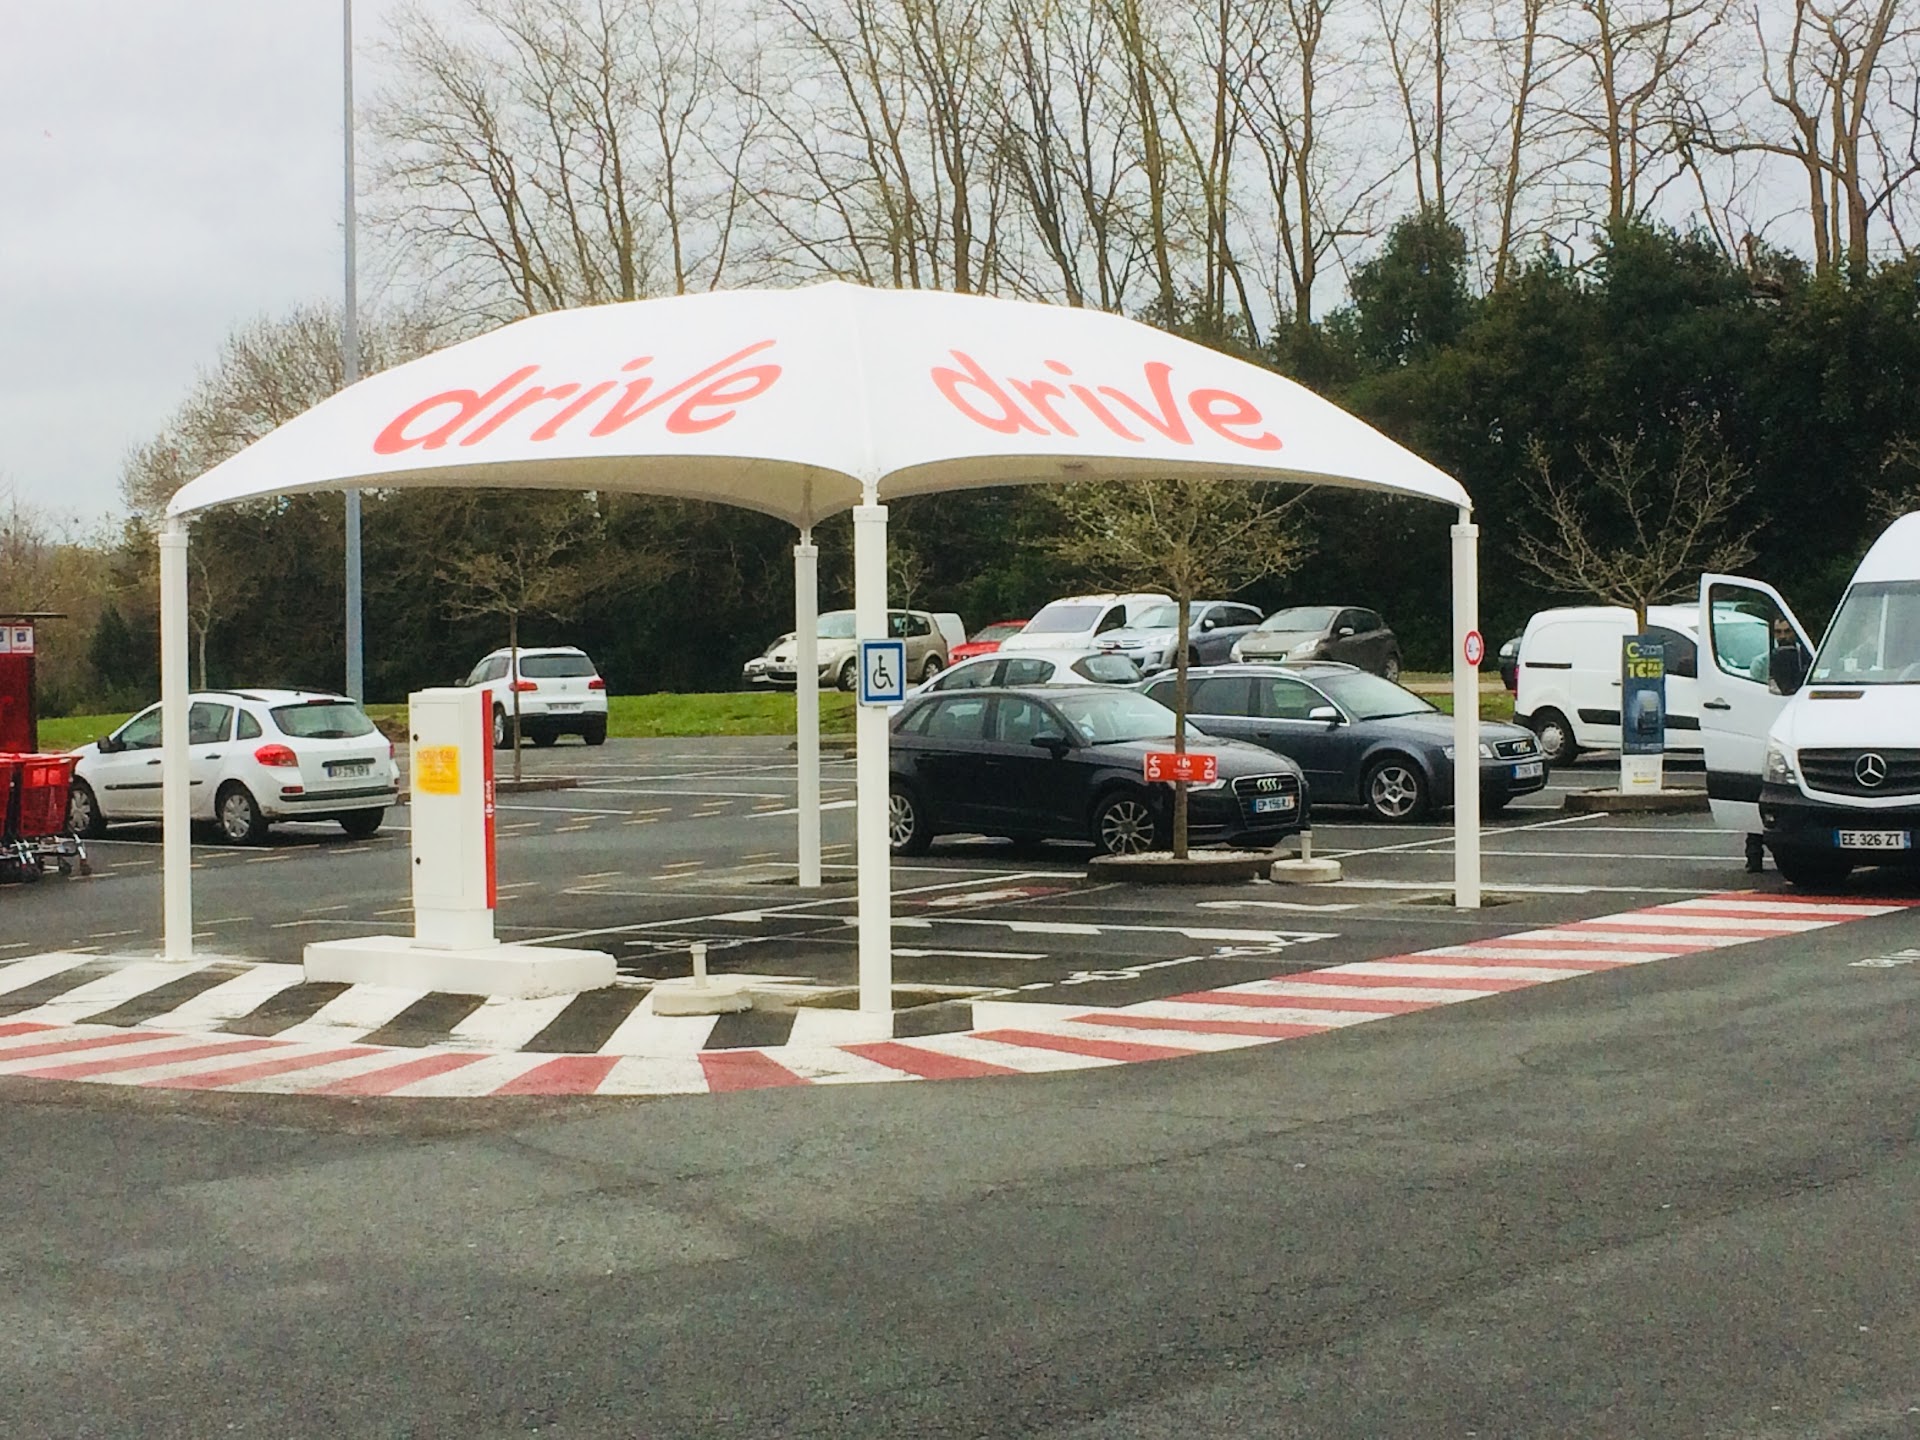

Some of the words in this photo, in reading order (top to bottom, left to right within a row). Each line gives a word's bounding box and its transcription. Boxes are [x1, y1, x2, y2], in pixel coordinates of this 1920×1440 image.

[372, 338, 783, 456] drive
[930, 349, 1284, 452] drive
[1842, 833, 1856, 845] EE
[1859, 833, 1882, 846] 326
[1885, 833, 1901, 846] ZT
